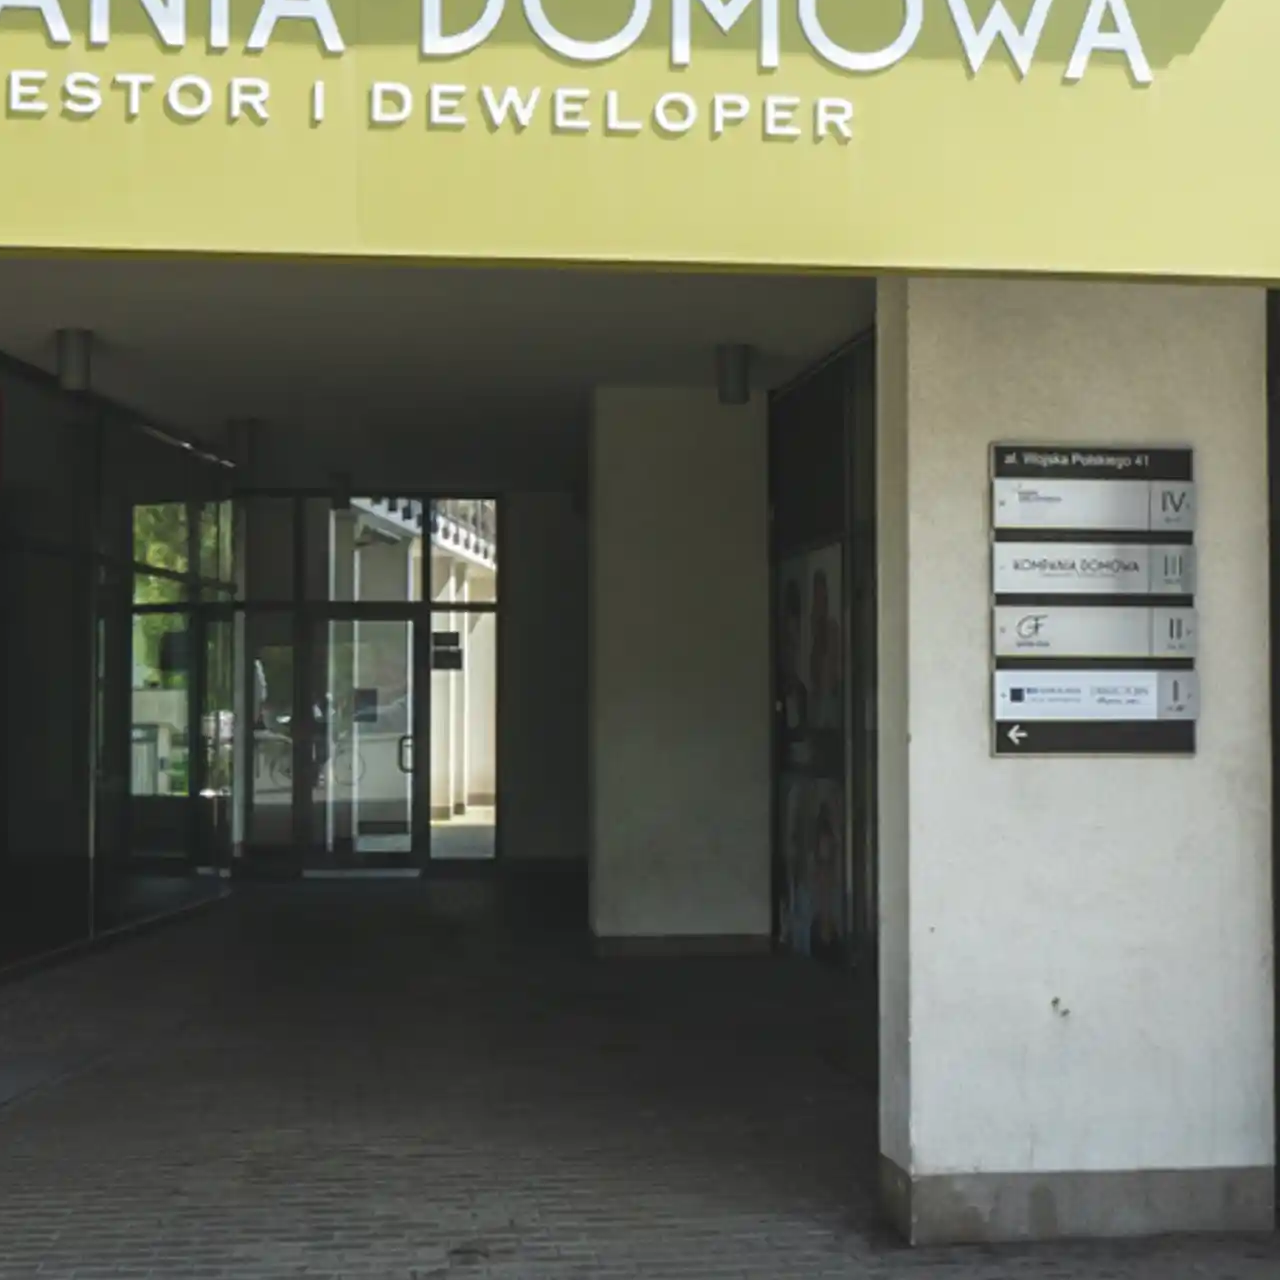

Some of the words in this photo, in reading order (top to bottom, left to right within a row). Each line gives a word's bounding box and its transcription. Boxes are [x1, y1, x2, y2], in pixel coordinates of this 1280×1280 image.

[313, 80, 325, 122] I
[371, 81, 855, 141] DEWELOPER
[1162, 490, 1186, 513] IV
